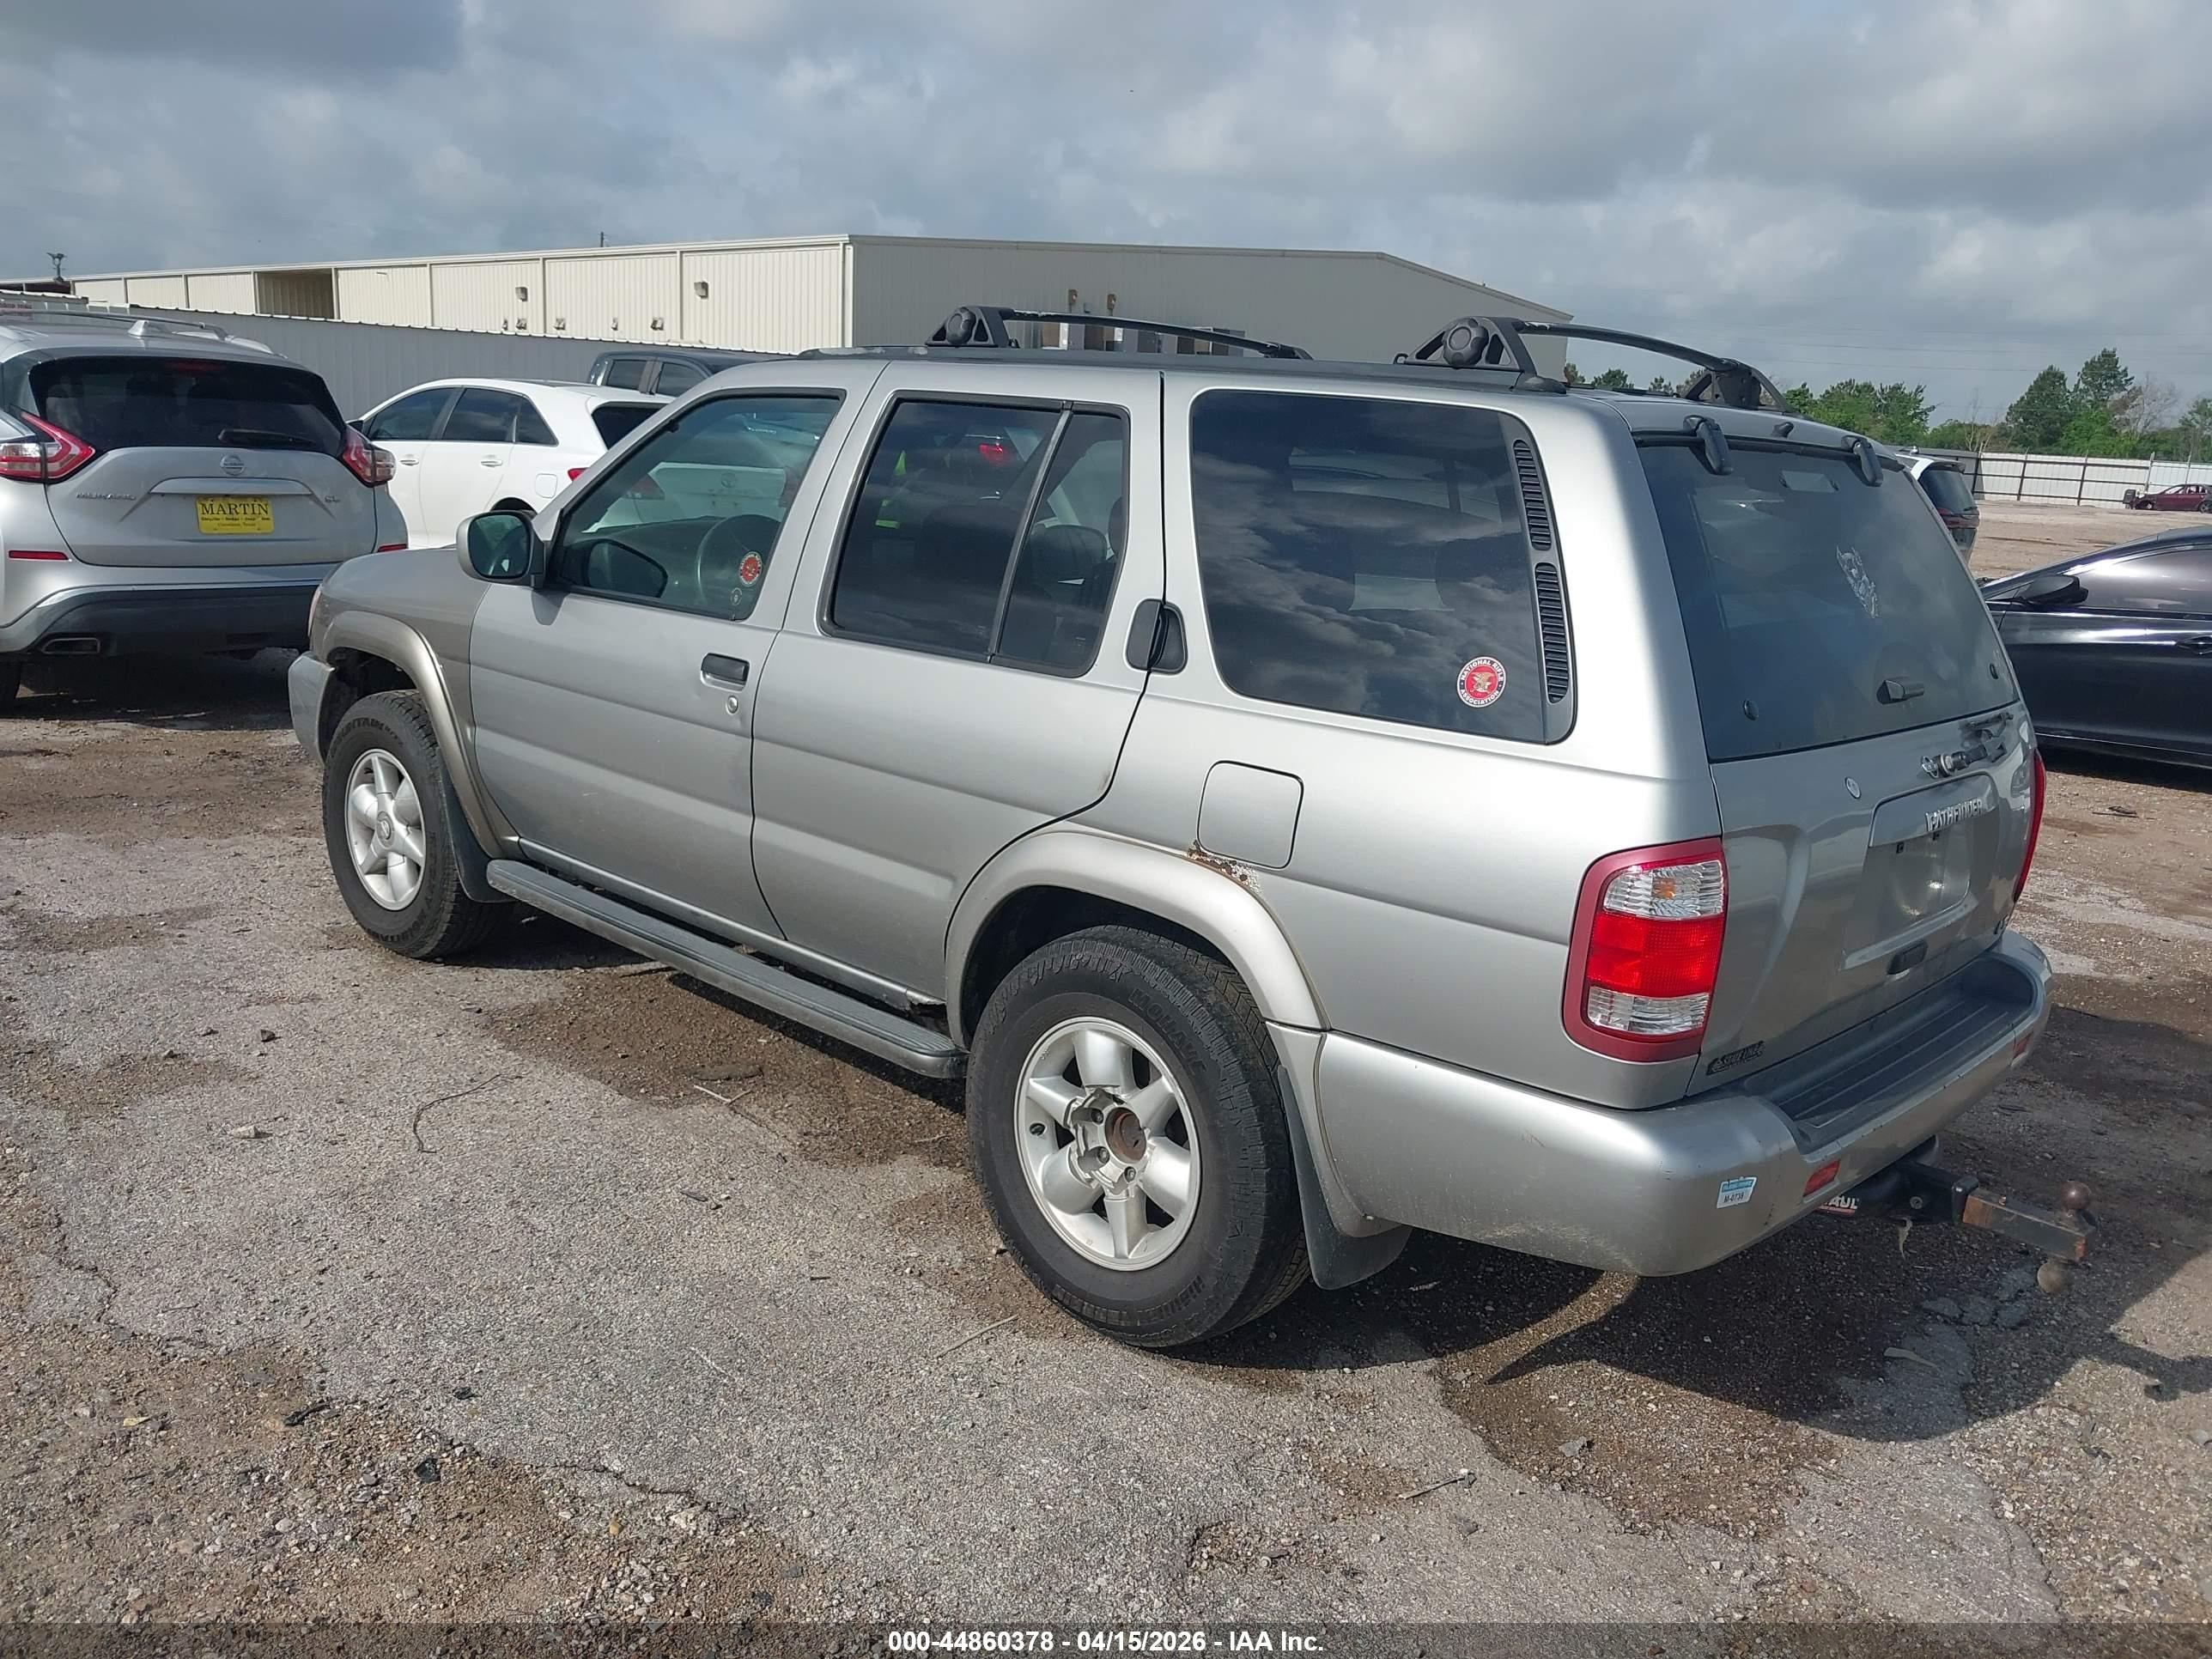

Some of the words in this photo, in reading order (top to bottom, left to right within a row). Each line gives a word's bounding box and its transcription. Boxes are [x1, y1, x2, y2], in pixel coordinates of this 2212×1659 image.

[200, 501, 269, 515] MARTIN
[1461, 659, 1492, 681] NATIONAL
[1492, 662, 1505, 682] RIFLE
[1460, 689, 1499, 705] ASSOCIATION
[1925, 799, 1983, 832] PATHFINDER
[1824, 1195, 1858, 1209] AUL
